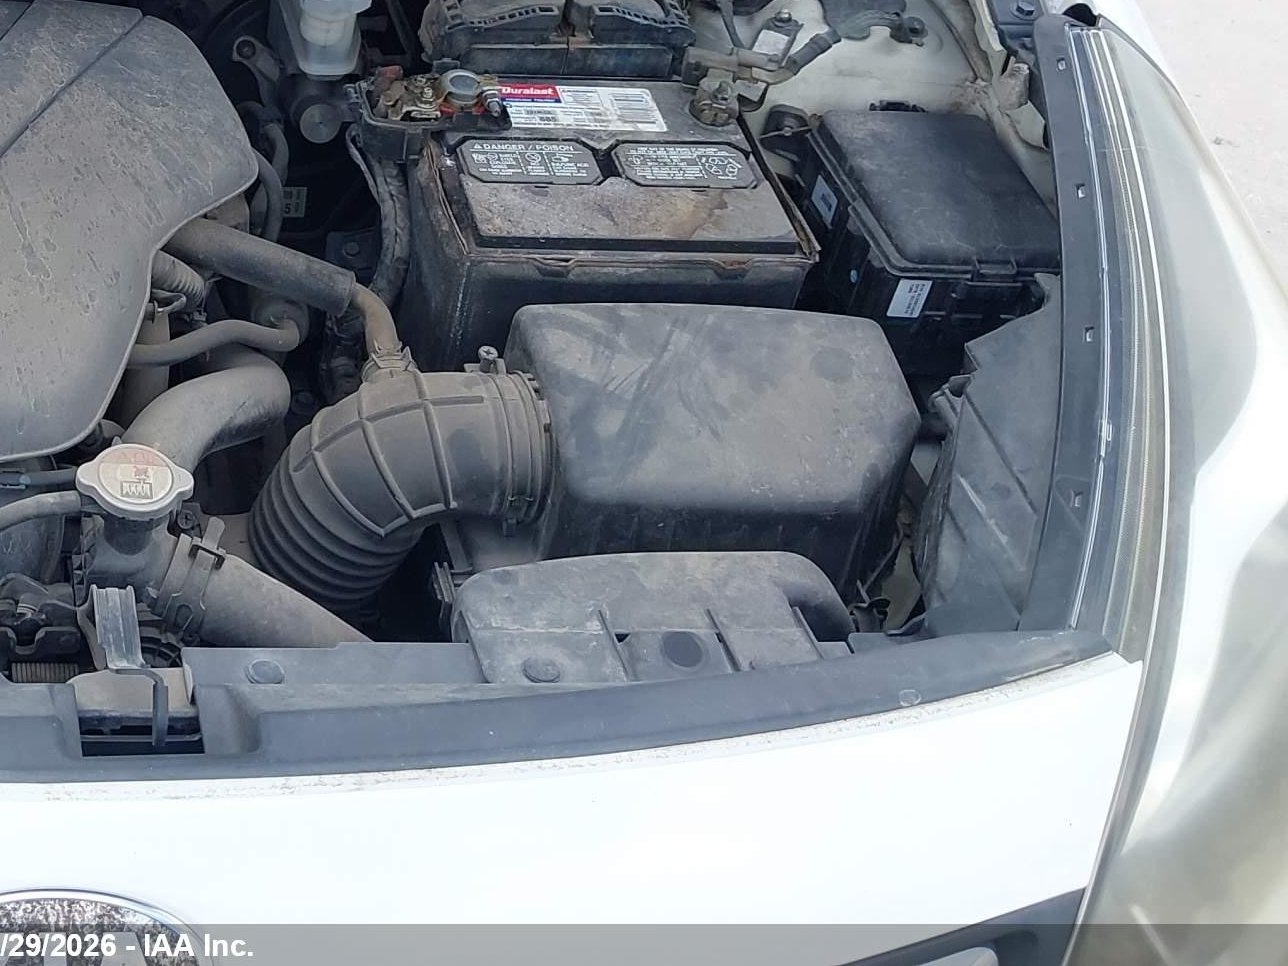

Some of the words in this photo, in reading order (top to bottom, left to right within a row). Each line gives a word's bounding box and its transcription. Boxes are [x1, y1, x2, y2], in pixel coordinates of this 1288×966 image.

[501, 86, 554, 95] Duralast
[482, 143, 525, 151] DANGER
[535, 144, 574, 152] POISON
